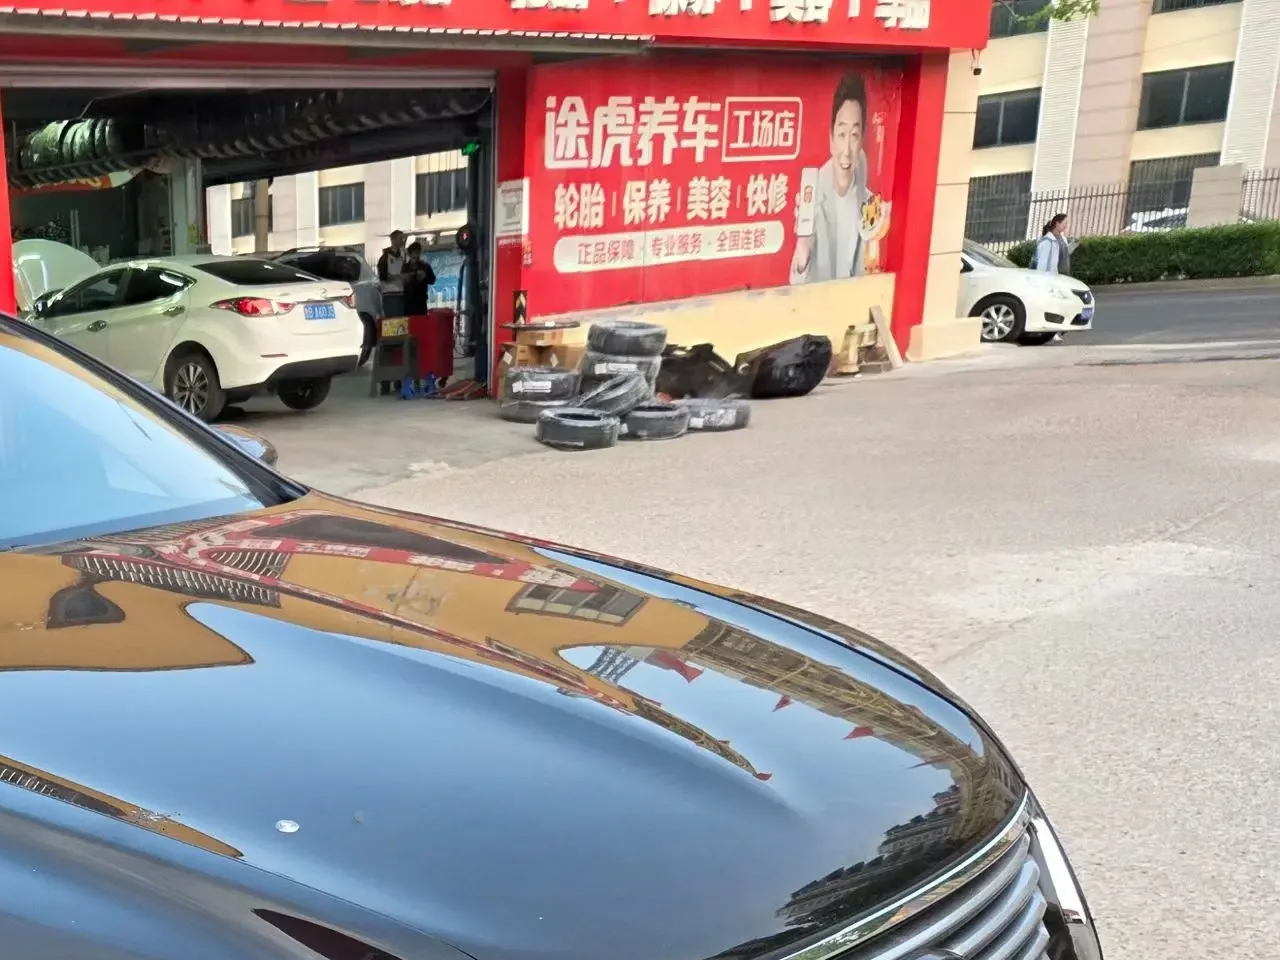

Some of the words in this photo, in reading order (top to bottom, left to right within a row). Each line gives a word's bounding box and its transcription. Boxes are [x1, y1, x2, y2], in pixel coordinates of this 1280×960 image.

[545, 96, 720, 168] 途虎养车
[729, 111, 796, 149] 工场店
[554, 183, 605, 231] 轮胎
[623, 179, 671, 225] 保养
[687, 176, 732, 221] 美容
[747, 173, 788, 216] 快修
[577, 239, 635, 265] 正品保障
[651, 233, 702, 258] 专业服务
[716, 227, 766, 253] 全国连锁
